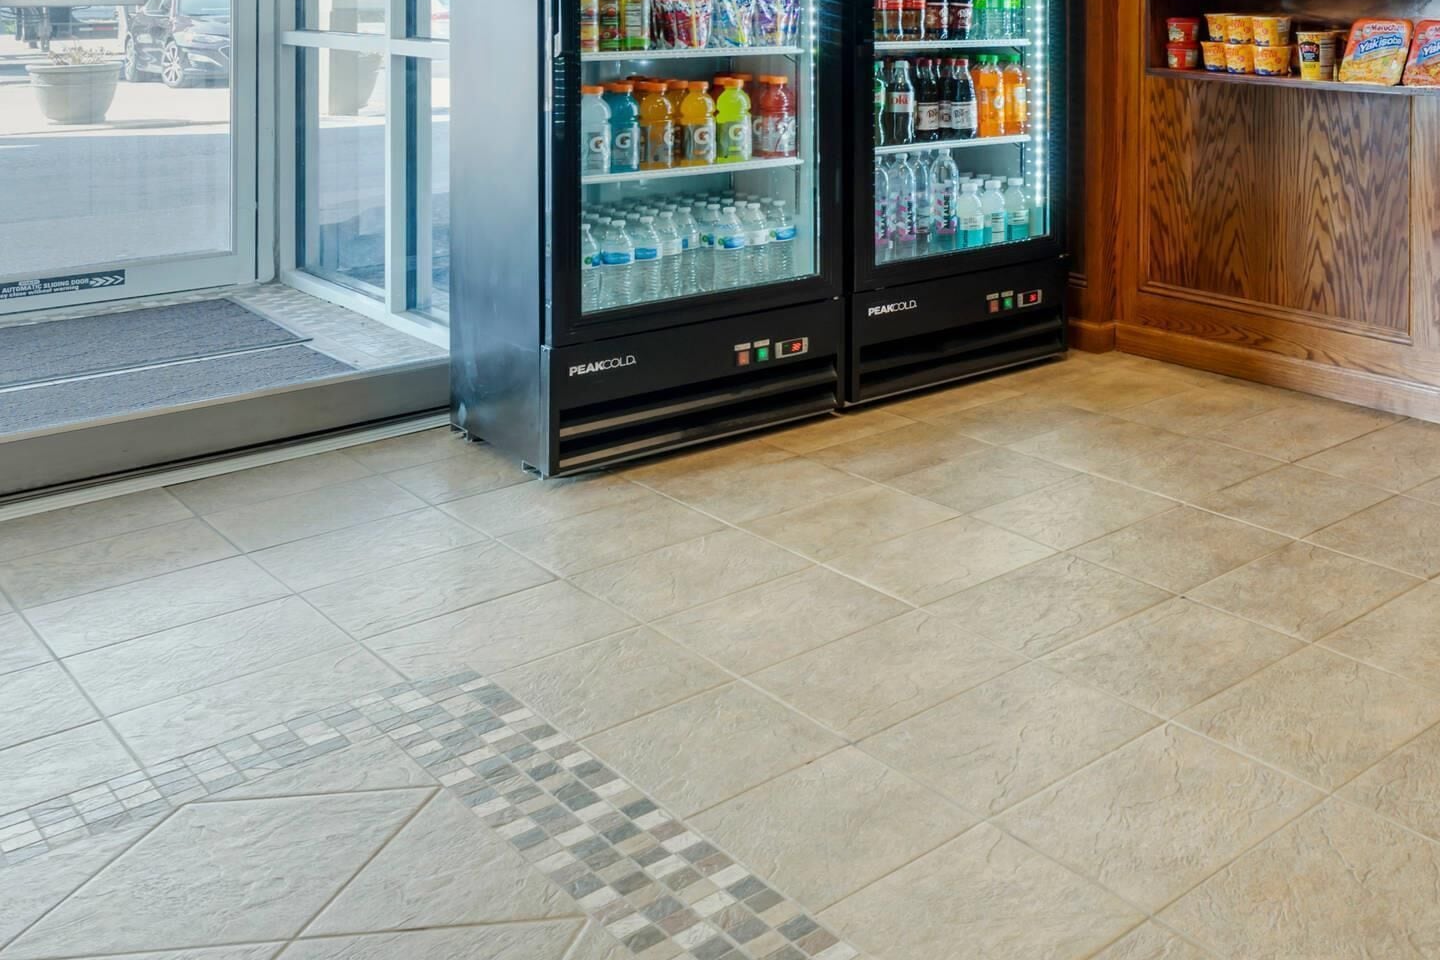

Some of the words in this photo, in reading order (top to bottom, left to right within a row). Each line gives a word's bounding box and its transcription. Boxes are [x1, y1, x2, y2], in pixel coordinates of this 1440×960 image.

[1371, 24, 1405, 33] Maruchan
[1359, 36, 1403, 54] Yakisoba
[2, 282, 42, 294] AUTOMATIC
[43, 280, 70, 289] SLIDING
[70, 278, 89, 286] DOOR
